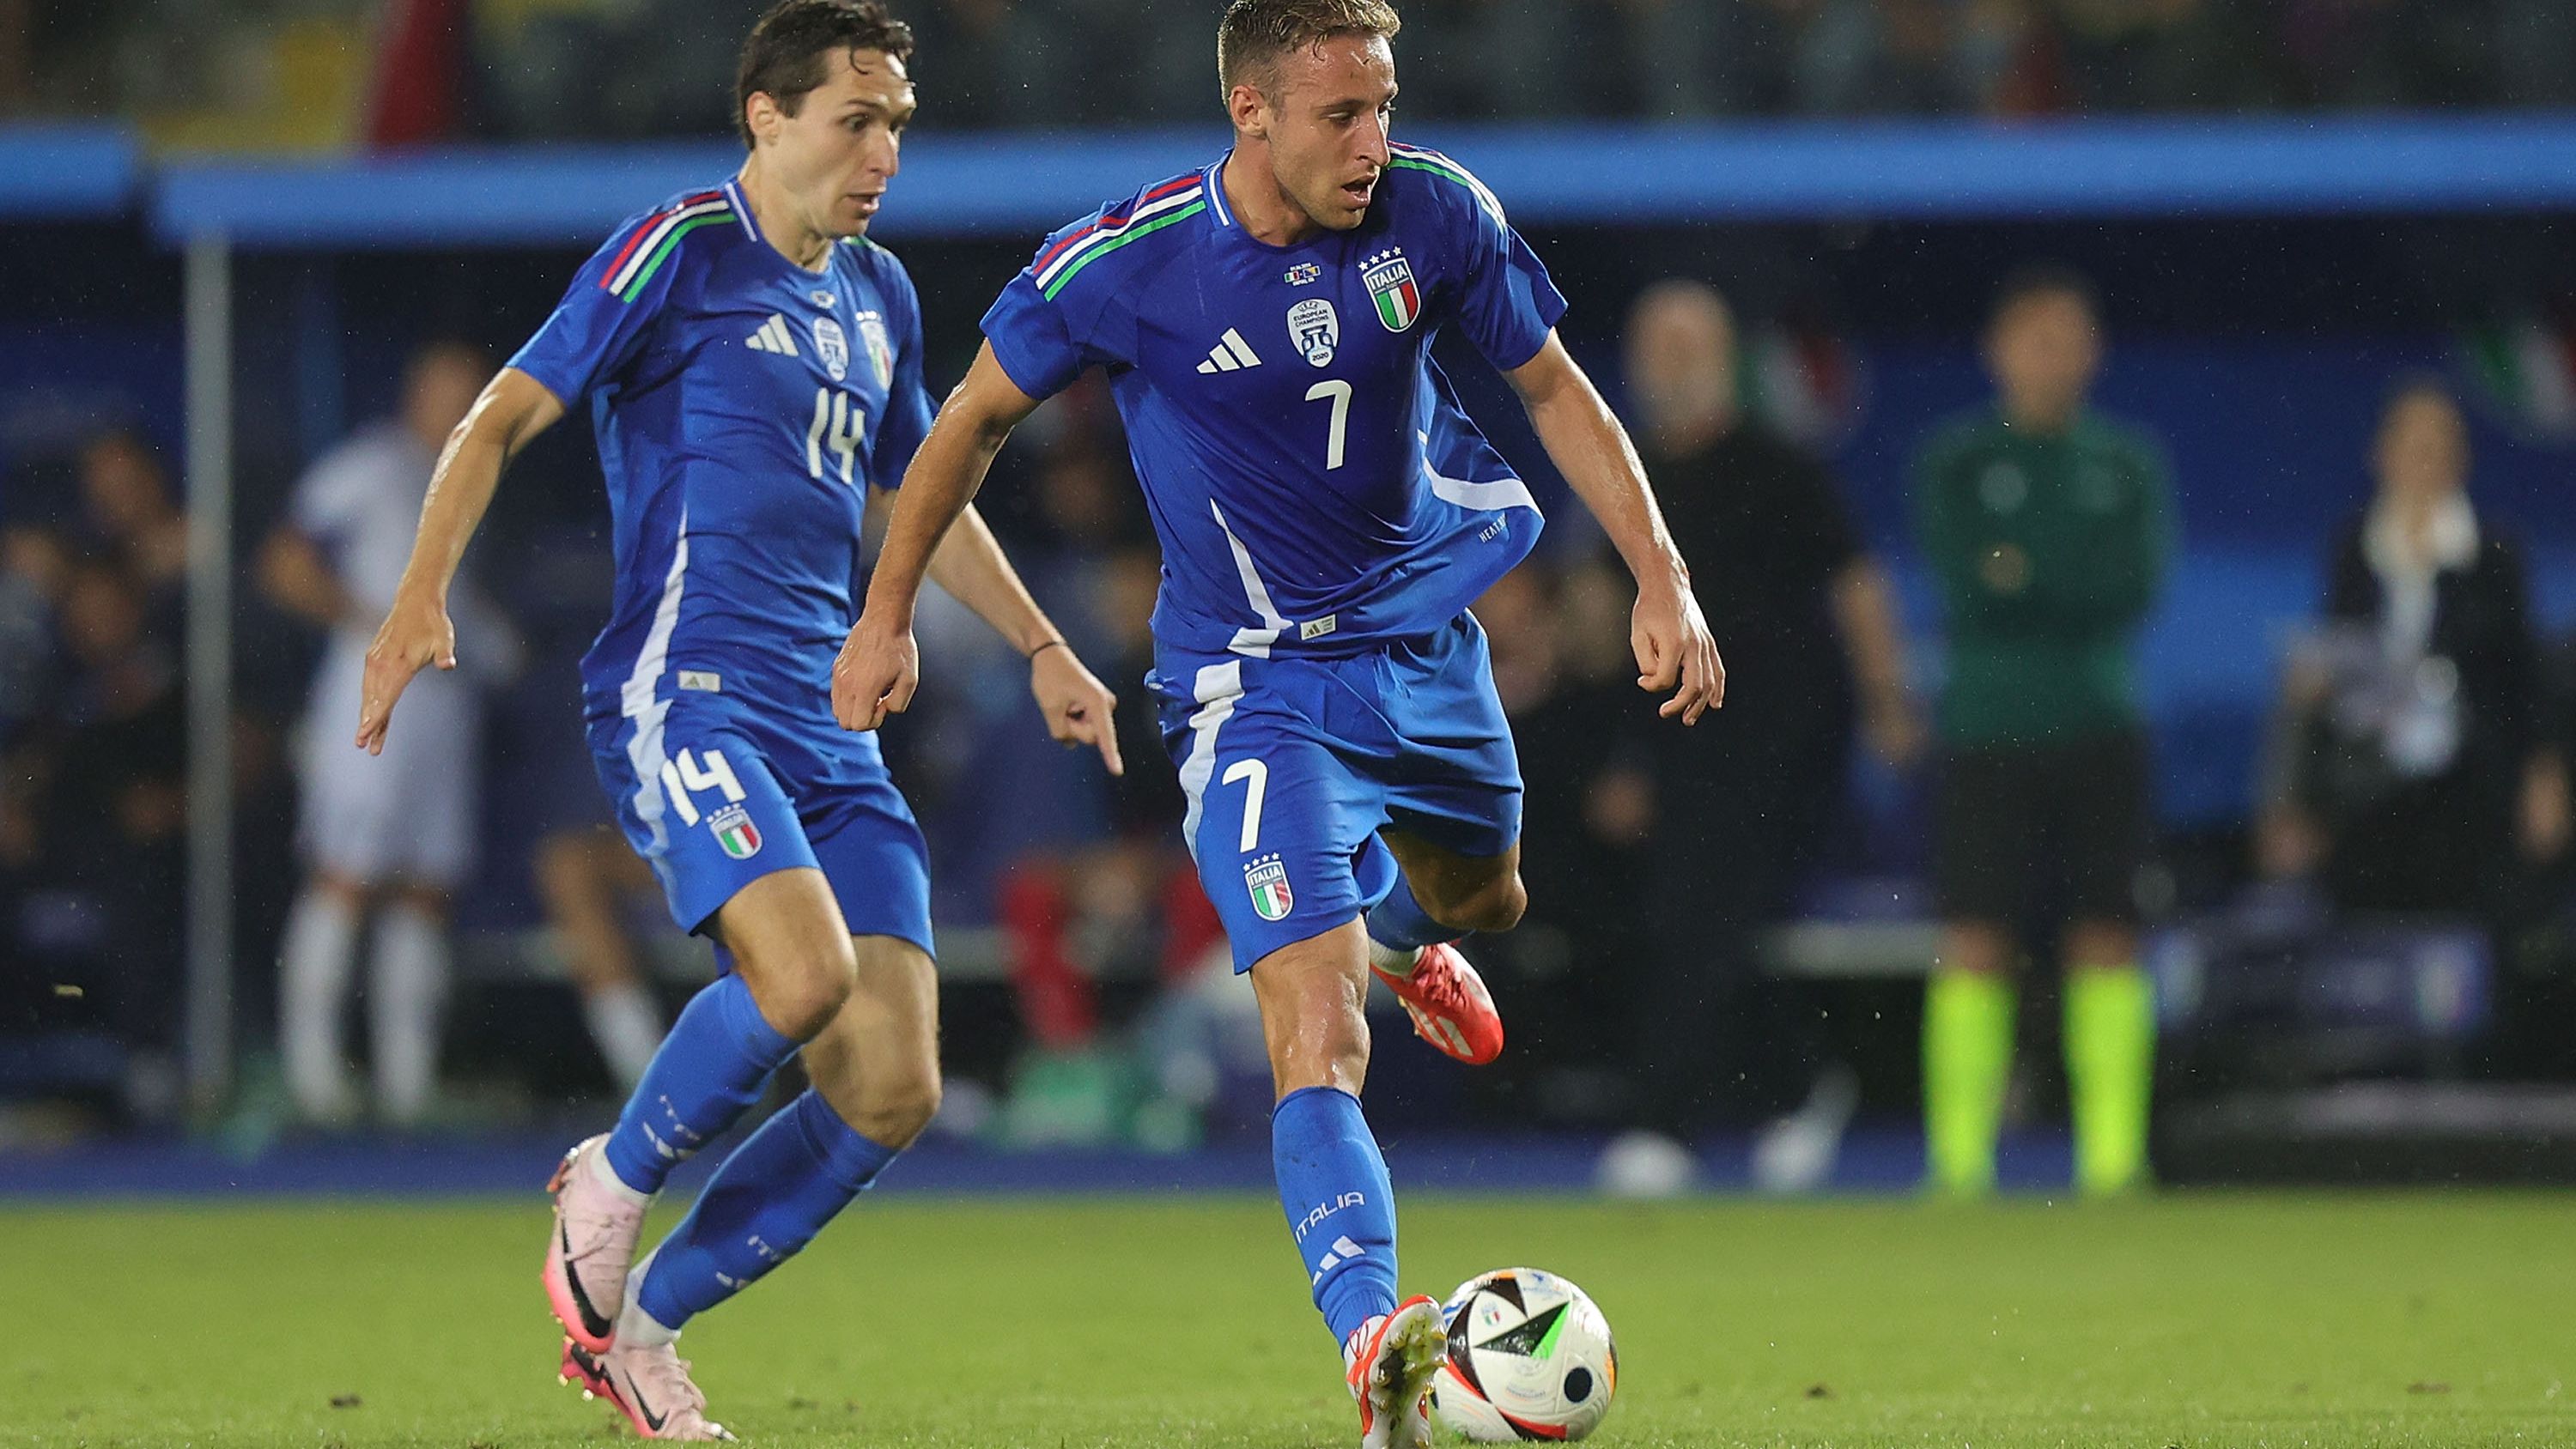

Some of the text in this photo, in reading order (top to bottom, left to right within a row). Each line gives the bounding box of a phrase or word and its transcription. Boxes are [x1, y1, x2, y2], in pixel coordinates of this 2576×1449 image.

[1368, 264, 1408, 290] ITALIA
[1293, 309, 1327, 322] EUROPEAN
[1295, 315, 1329, 327] CHAMPIONS
[1312, 351, 1329, 361] 2020
[807, 387, 866, 485] 14
[1305, 379, 1352, 470] 7
[661, 747, 747, 828] 14
[1222, 758, 1268, 853] 7
[1249, 865, 1282, 886] ITALIA
[1295, 1191, 1365, 1245] ITALIA
